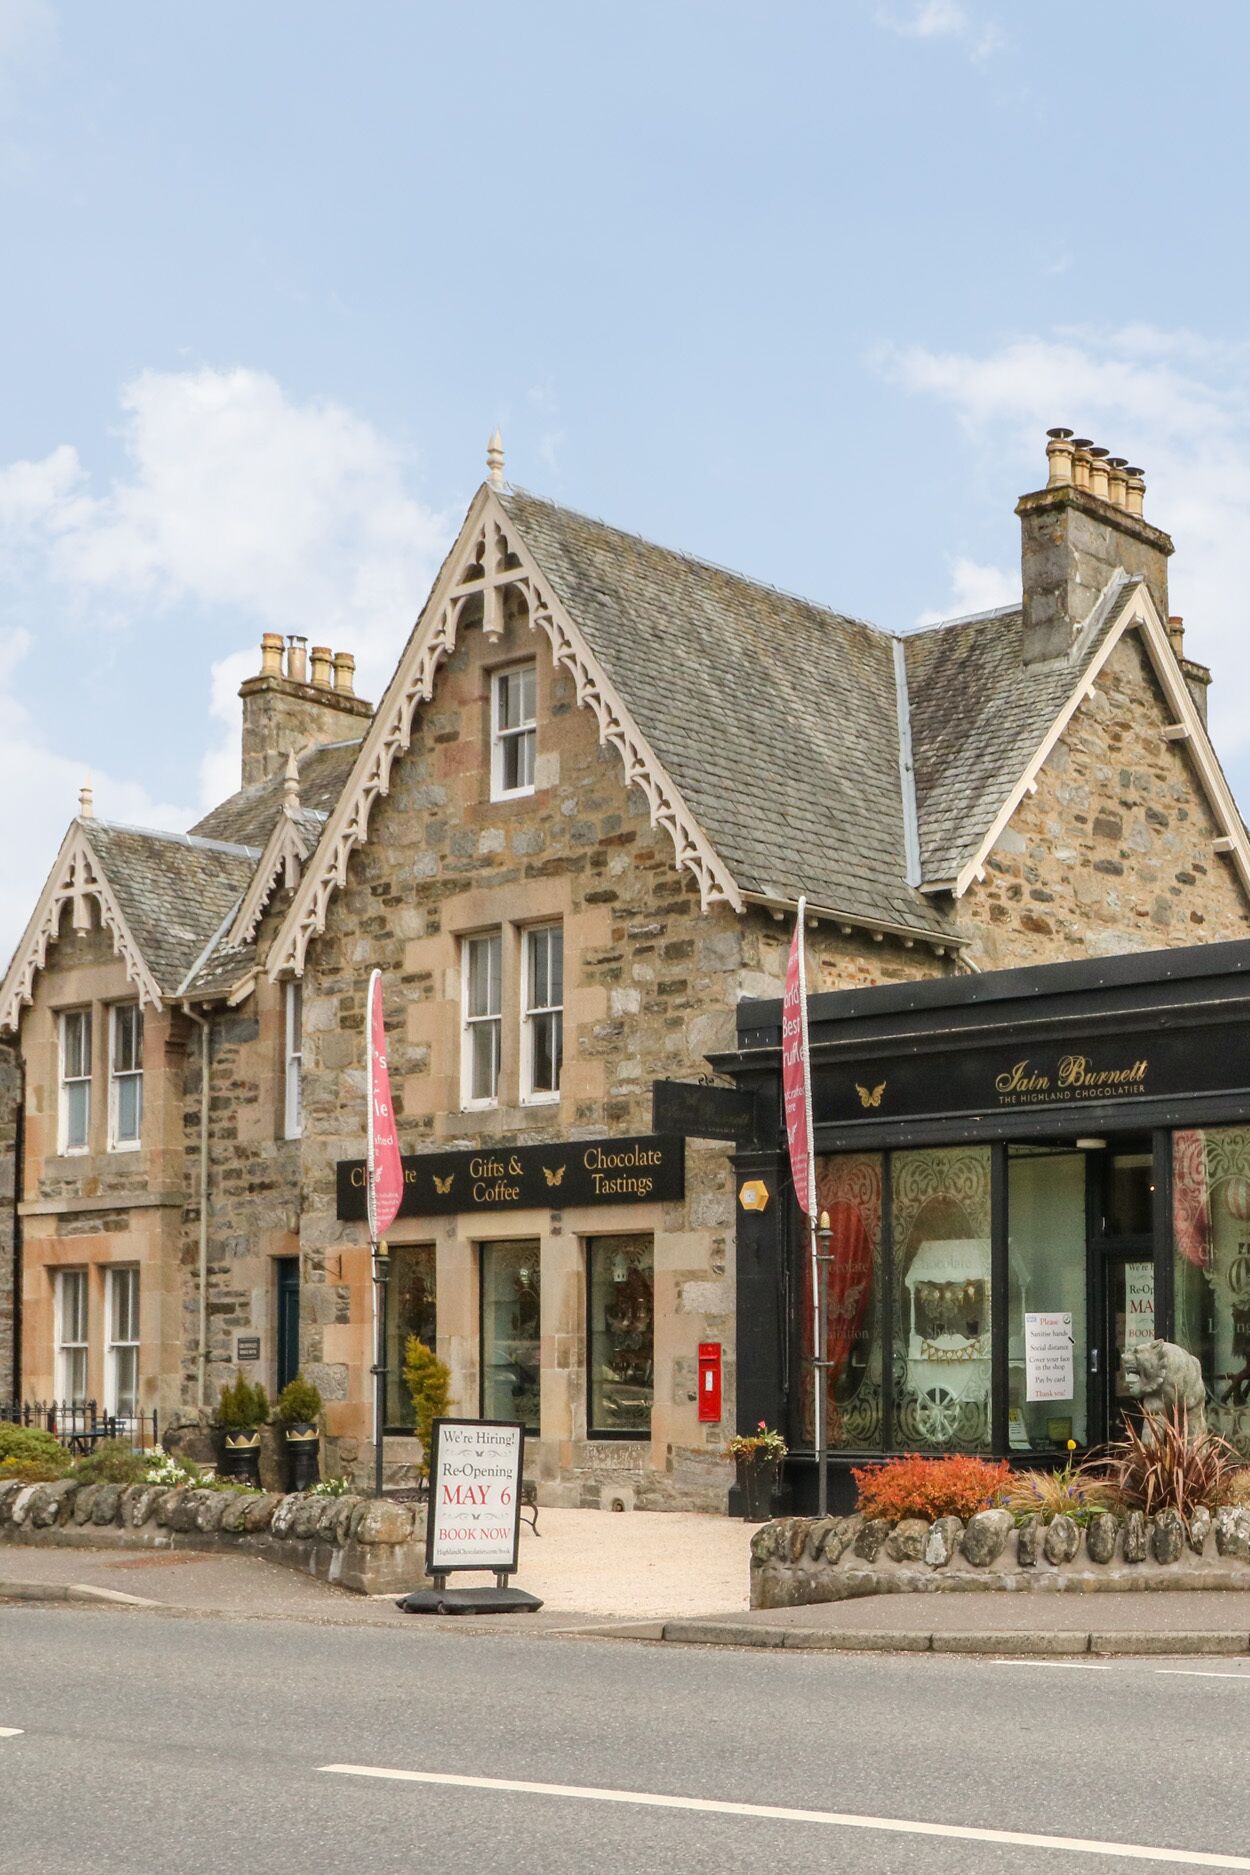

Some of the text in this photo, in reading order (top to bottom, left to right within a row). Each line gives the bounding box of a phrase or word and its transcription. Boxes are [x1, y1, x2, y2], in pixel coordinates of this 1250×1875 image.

[783, 1016, 800, 1038] Best
[783, 1041, 806, 1067] ruffle
[995, 1055, 1148, 1093] Iain Burnett
[999, 1084, 1146, 1105] THE HIGHLAND CHOCOLATIER
[469, 1155, 524, 1180] Gifts &
[583, 1146, 662, 1169] Chocolate
[472, 1181, 520, 1202] Coffee
[591, 1173, 653, 1198] Tastings
[1129, 1284, 1154, 1296] Re-Op
[1130, 1300, 1154, 1313] MA
[1052, 1363, 1065, 1371] shop
[1046, 1376, 1053, 1384] by
[443, 1430, 515, 1447] We're Hiring!
[442, 1463, 513, 1480] Re-Opening
[442, 1485, 511, 1505] MAY 6
[439, 1528, 511, 1541] BOOK NOW
